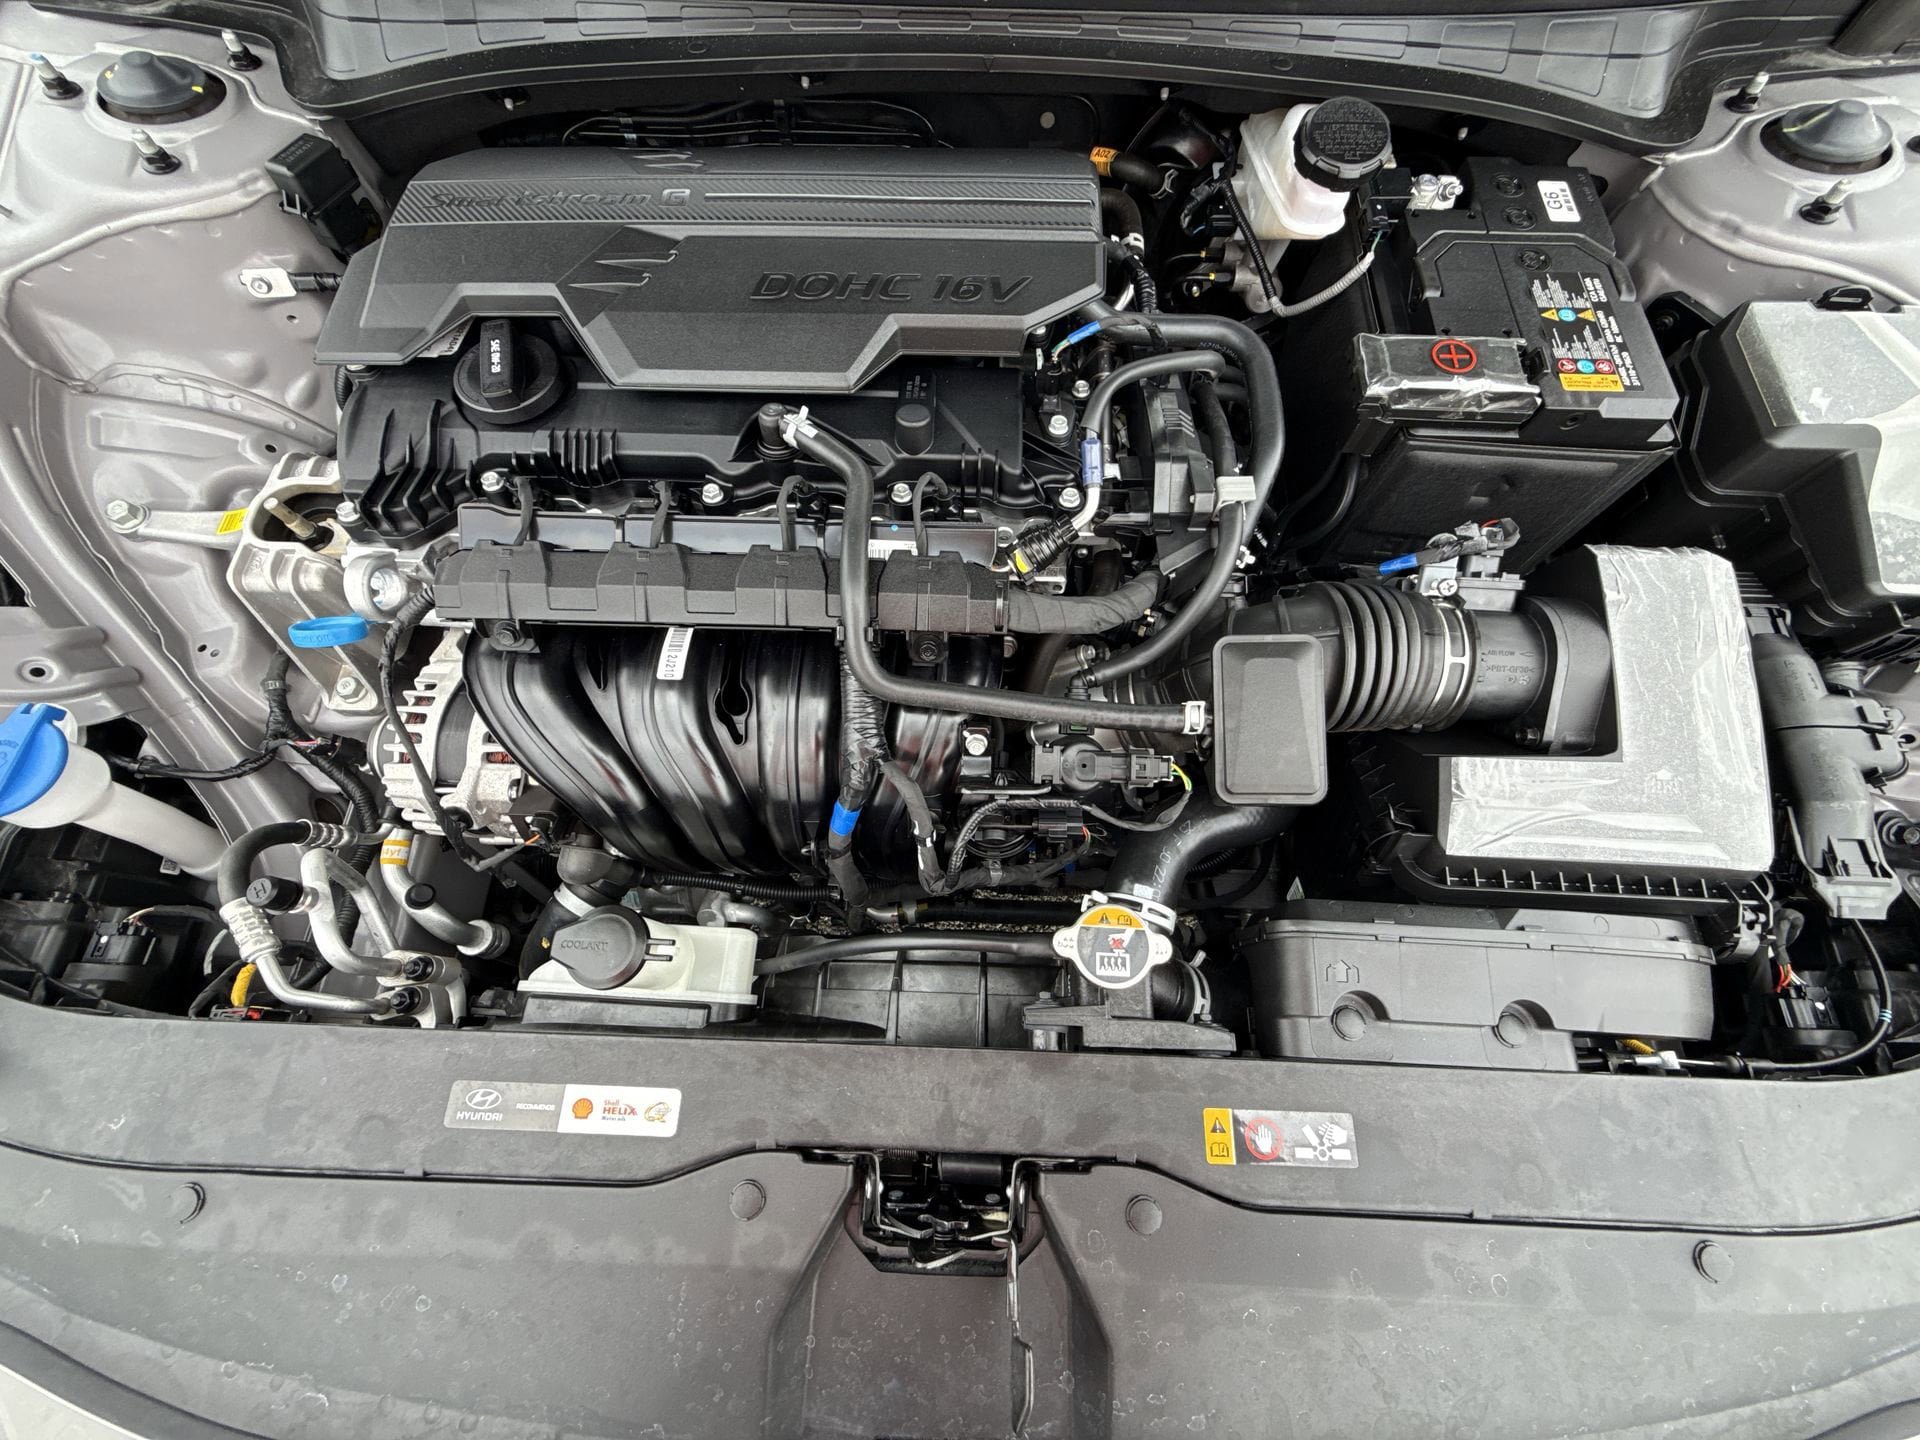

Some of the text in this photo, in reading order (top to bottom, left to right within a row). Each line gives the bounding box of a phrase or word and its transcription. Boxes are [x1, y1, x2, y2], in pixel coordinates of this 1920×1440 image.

[659, 188, 691, 207] G
[1544, 191, 1563, 211] G6
[750, 271, 1033, 303] DOHC 16V
[1589, 290, 1599, 302] CCA
[490, 339, 501, 352] SAE
[560, 939, 609, 952] COOLANT
[456, 1111, 503, 1122] HYUNDAI
[602, 1104, 638, 1116] HELIX
